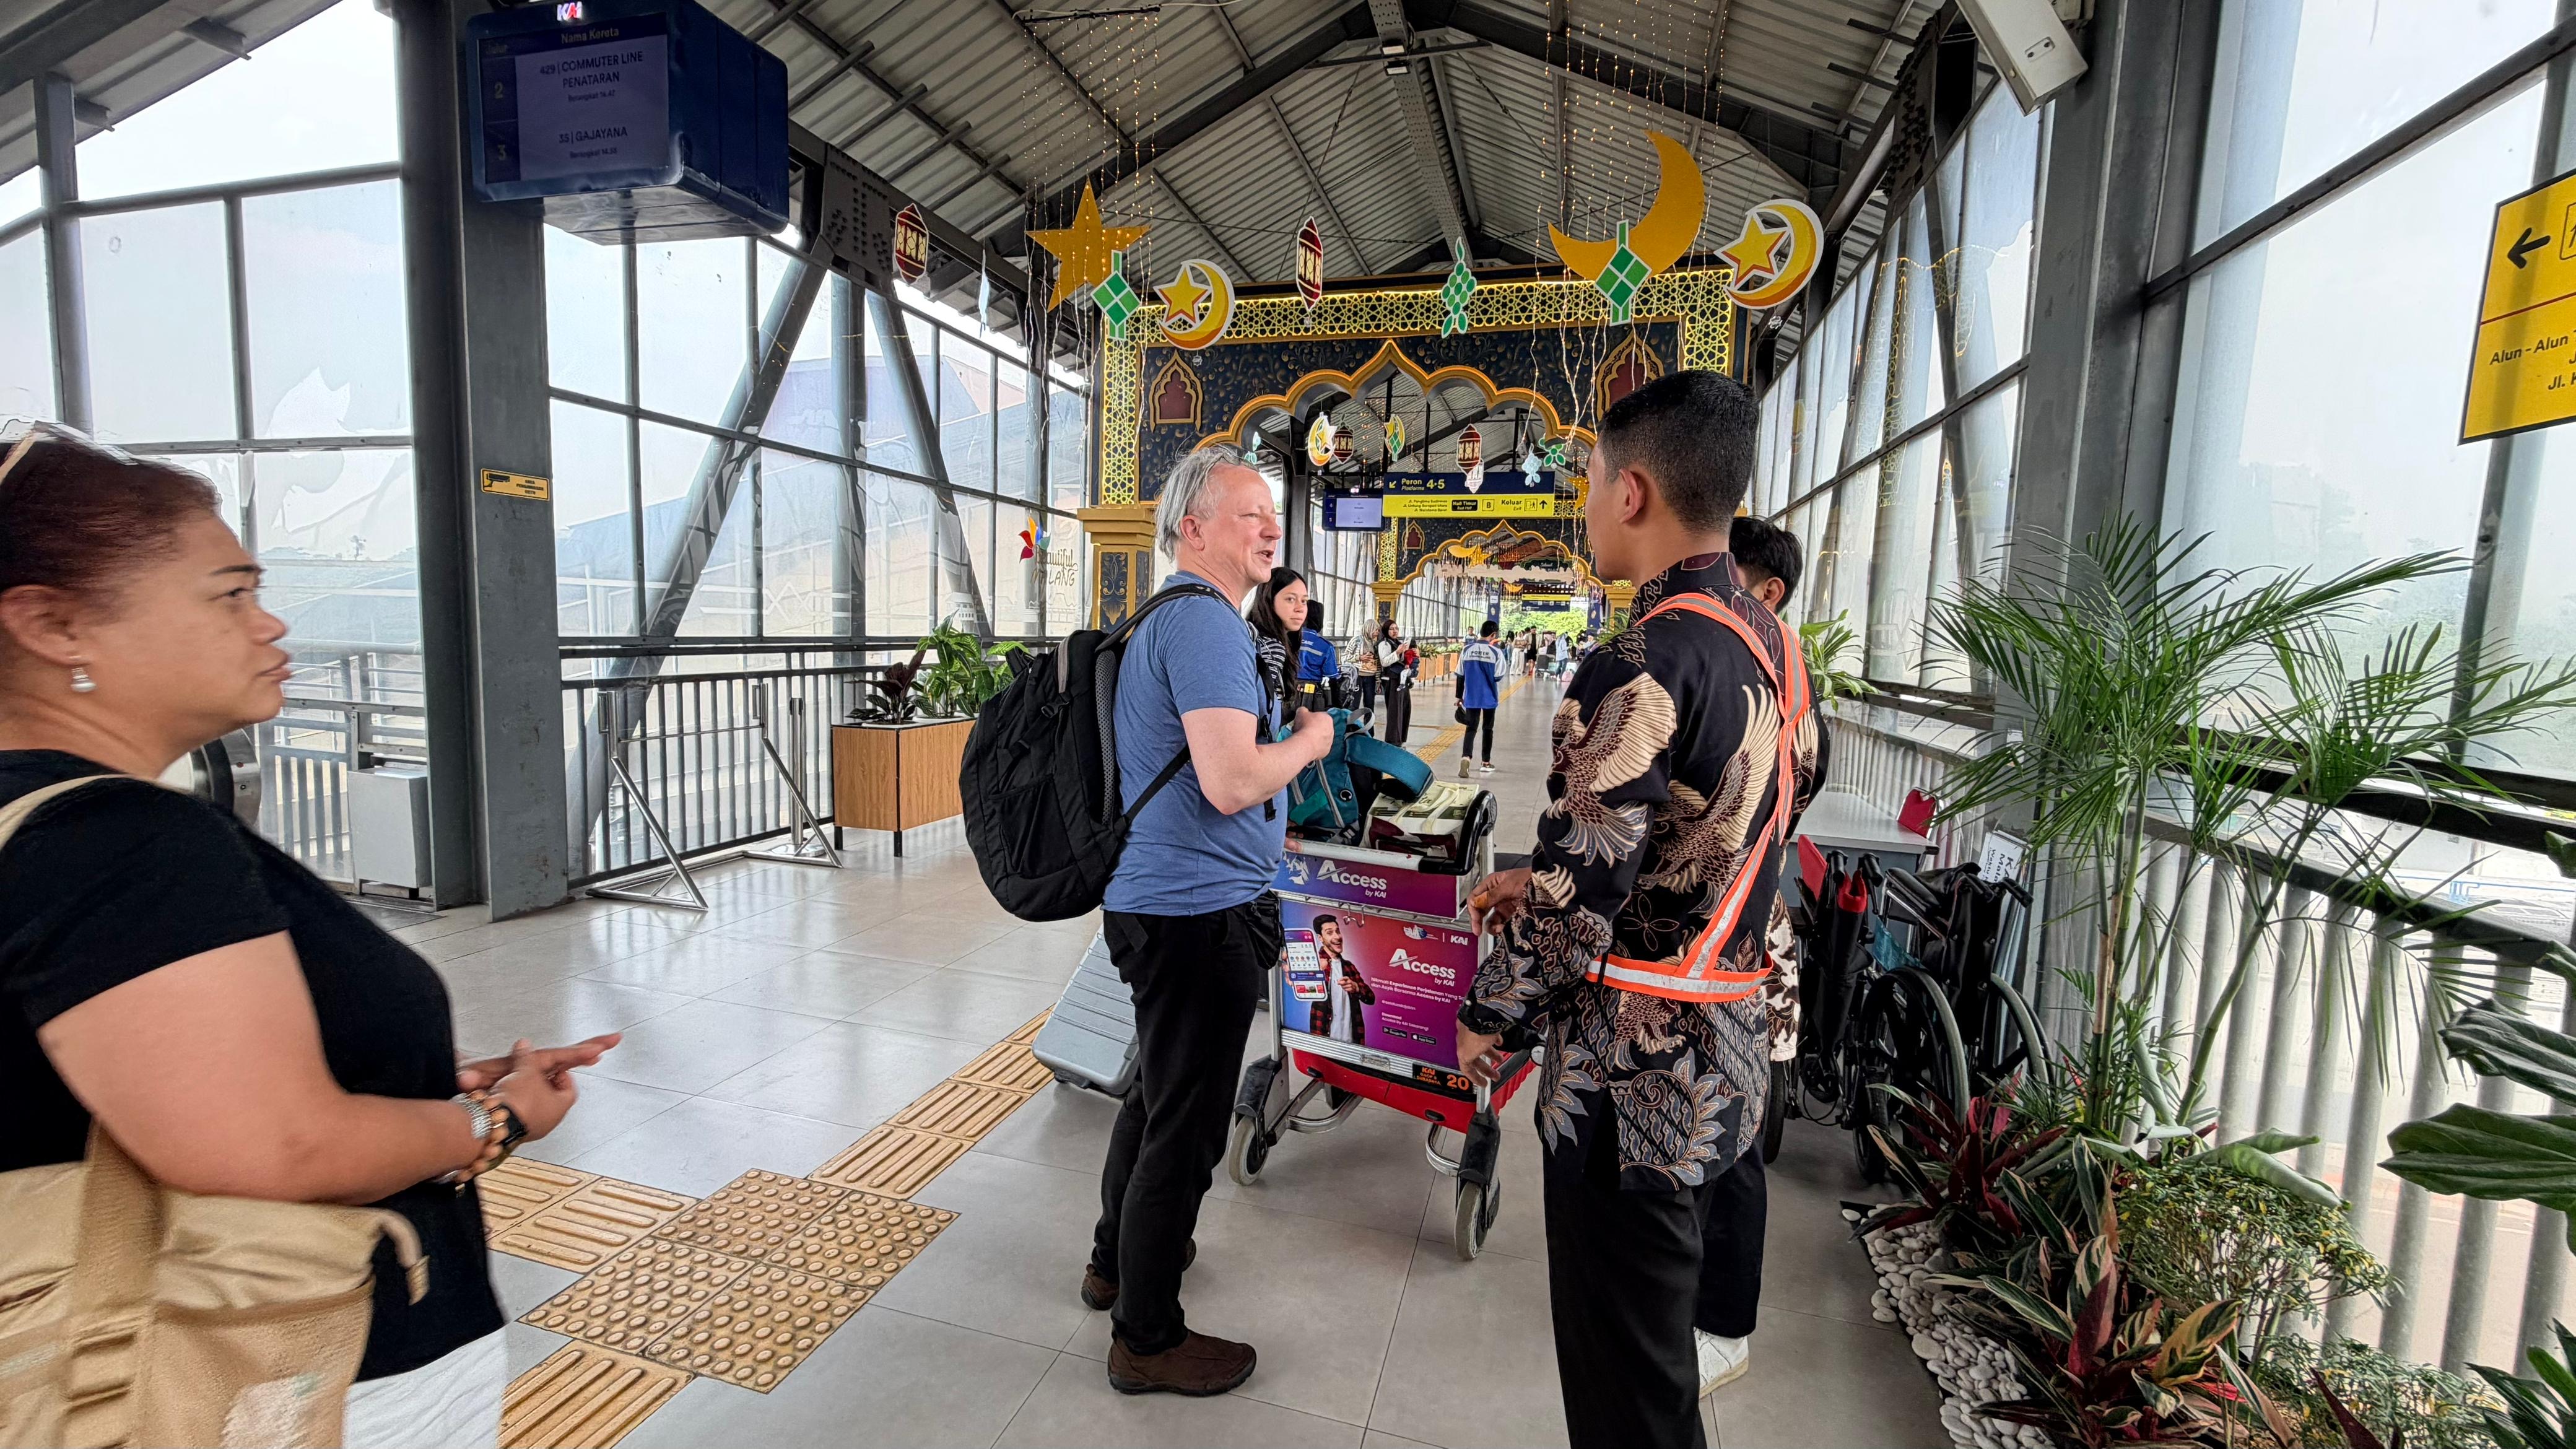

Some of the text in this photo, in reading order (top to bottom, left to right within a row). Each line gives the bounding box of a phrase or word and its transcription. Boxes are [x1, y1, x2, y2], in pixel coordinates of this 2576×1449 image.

[557, 1, 583, 21] KAI
[561, 28, 619, 44] Nama Kereta
[540, 64, 556, 75] 429
[562, 54, 619, 72] COMMUTER
[621, 51, 643, 64] LINE
[563, 72, 619, 89] PENATARAN
[494, 82, 503, 99] 2
[559, 133, 569, 144] 35
[576, 126, 628, 141] GAJAYANA
[497, 144, 507, 160] 3
[2489, 349, 2522, 365] Alun
[2533, 336, 2569, 354] Alun
[2548, 375, 2565, 390] Jl.
[1316, 859, 1387, 890] Access
[1365, 889, 1387, 899] by KAI
[1450, 935, 1468, 946] KAI
[1389, 949, 1456, 980] Access
[1390, 980, 1417, 991] Experience
[1417, 986, 1444, 996] Perjalanan
[1445, 993, 1457, 1001] Yang
[1394, 987, 1416, 996] Bersama
[1422, 1067, 1435, 1075] KAI
[1447, 1074, 1469, 1090] 20
